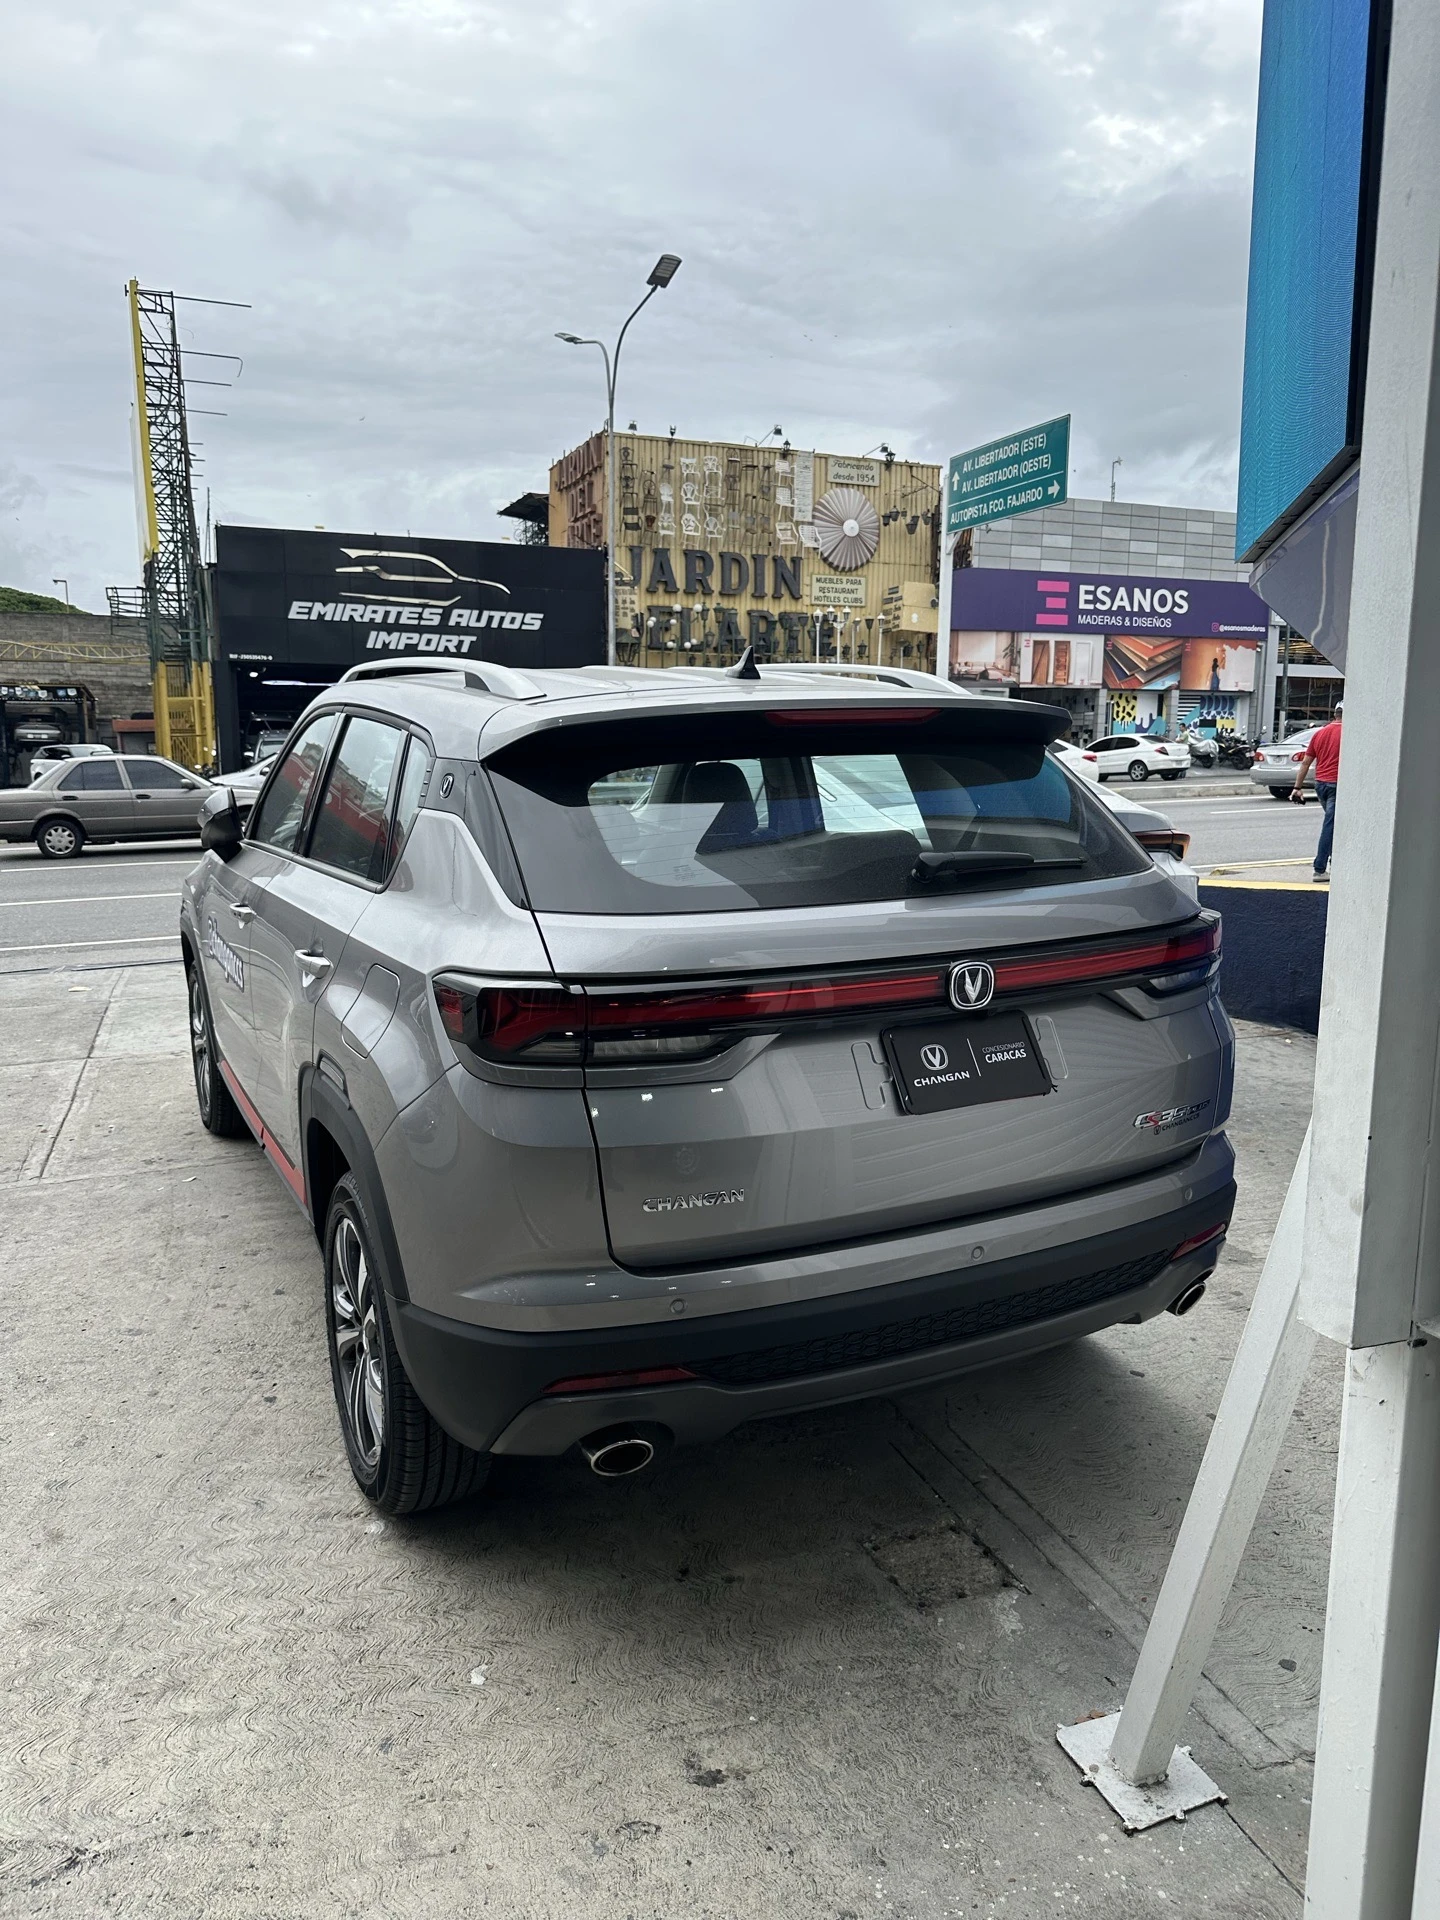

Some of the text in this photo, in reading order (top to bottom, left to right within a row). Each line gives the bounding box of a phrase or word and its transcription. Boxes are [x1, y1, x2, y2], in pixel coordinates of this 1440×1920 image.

[555, 435, 603, 492] JARDIN
[831, 459, 874, 471] Fabricando
[962, 433, 1047, 474] AV. LIBERTADOR (ESTE)
[832, 472, 875, 483] desde 1954
[961, 454, 1052, 494] AV. LIBERTADOR (OESTE)
[568, 481, 597, 523] DEL
[949, 486, 1044, 525] AUTOPISTA FCO. FAJARDO
[615, 546, 803, 599] JARDIN
[815, 576, 863, 586] MUEBLES PARA
[813, 594, 863, 604] HOTELES CLUBS
[818, 586, 859, 595] RESTAURANT
[1078, 584, 1189, 614] ESANOS
[287, 601, 544, 632] EMIRATES AUTOS
[1077, 614, 1172, 628] MADERAS & DISEÑOS
[366, 630, 478, 653] IMPORT
[981, 1041, 1026, 1054] CONCESIONARIO
[985, 1048, 1027, 1064] CARACAS
[913, 1070, 971, 1087] CHANGAN
[642, 1188, 745, 1212] CHANGAN
